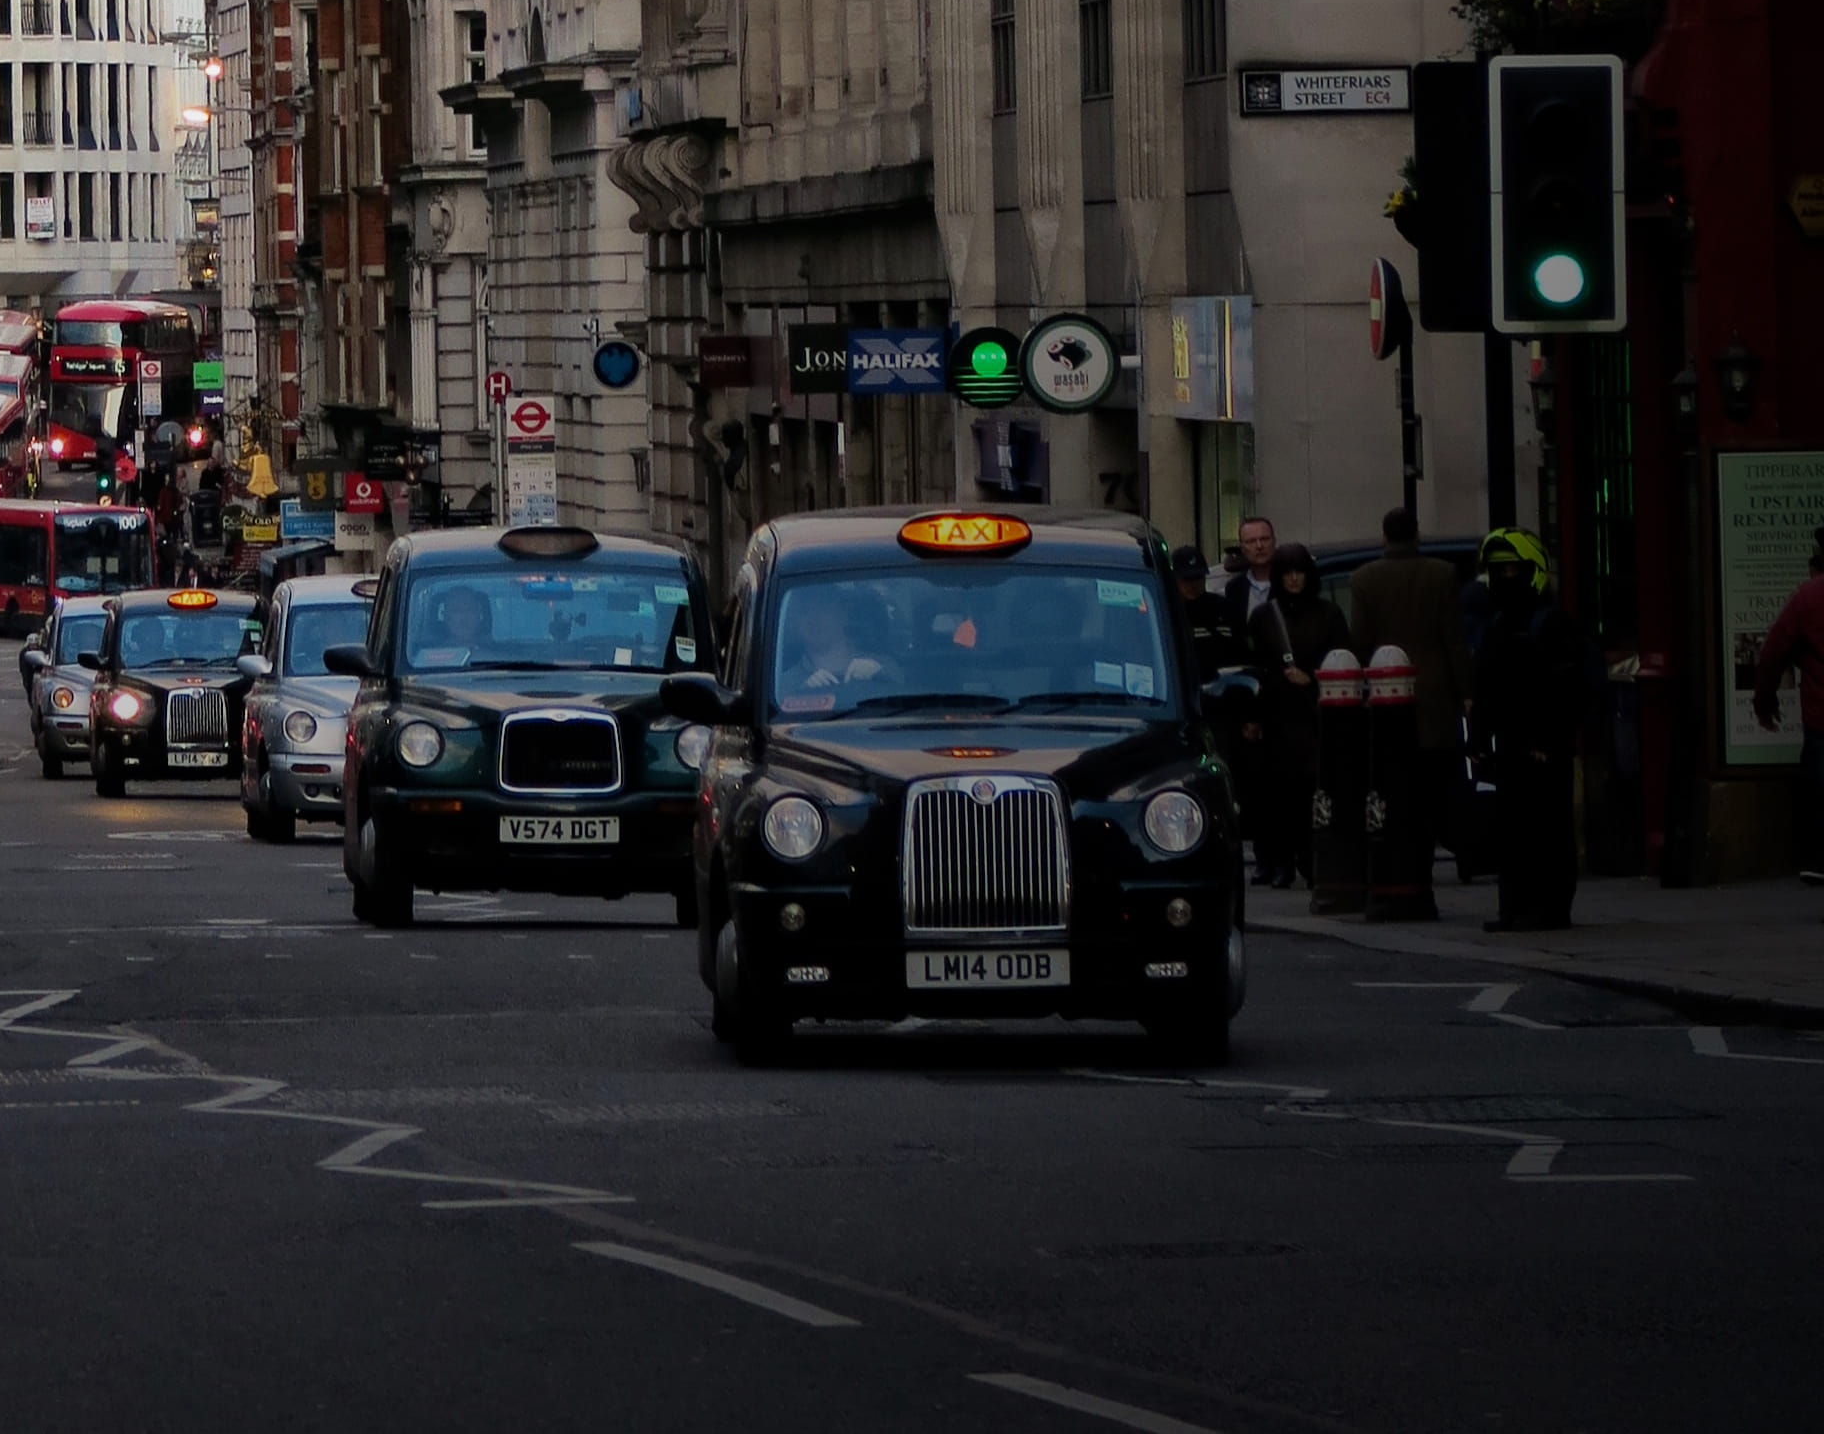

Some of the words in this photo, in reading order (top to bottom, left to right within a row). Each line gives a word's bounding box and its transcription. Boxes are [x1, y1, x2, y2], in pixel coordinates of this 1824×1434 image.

[1295, 75, 1391, 89] WHITEFRIARS
[1295, 92, 1346, 105] STREET
[1365, 91, 1391, 104] EC4
[794, 347, 848, 372] JON
[852, 352, 941, 370] HALIFAX
[490, 375, 506, 396] H
[1054, 371, 1089, 387] wasabi
[119, 515, 137, 530] 100
[928, 522, 1004, 541] TAXI
[174, 753, 198, 765] LP14
[509, 819, 564, 839] V574
[571, 818, 611, 839] DGT
[924, 954, 988, 981] LM14
[996, 952, 1052, 980] ODB
